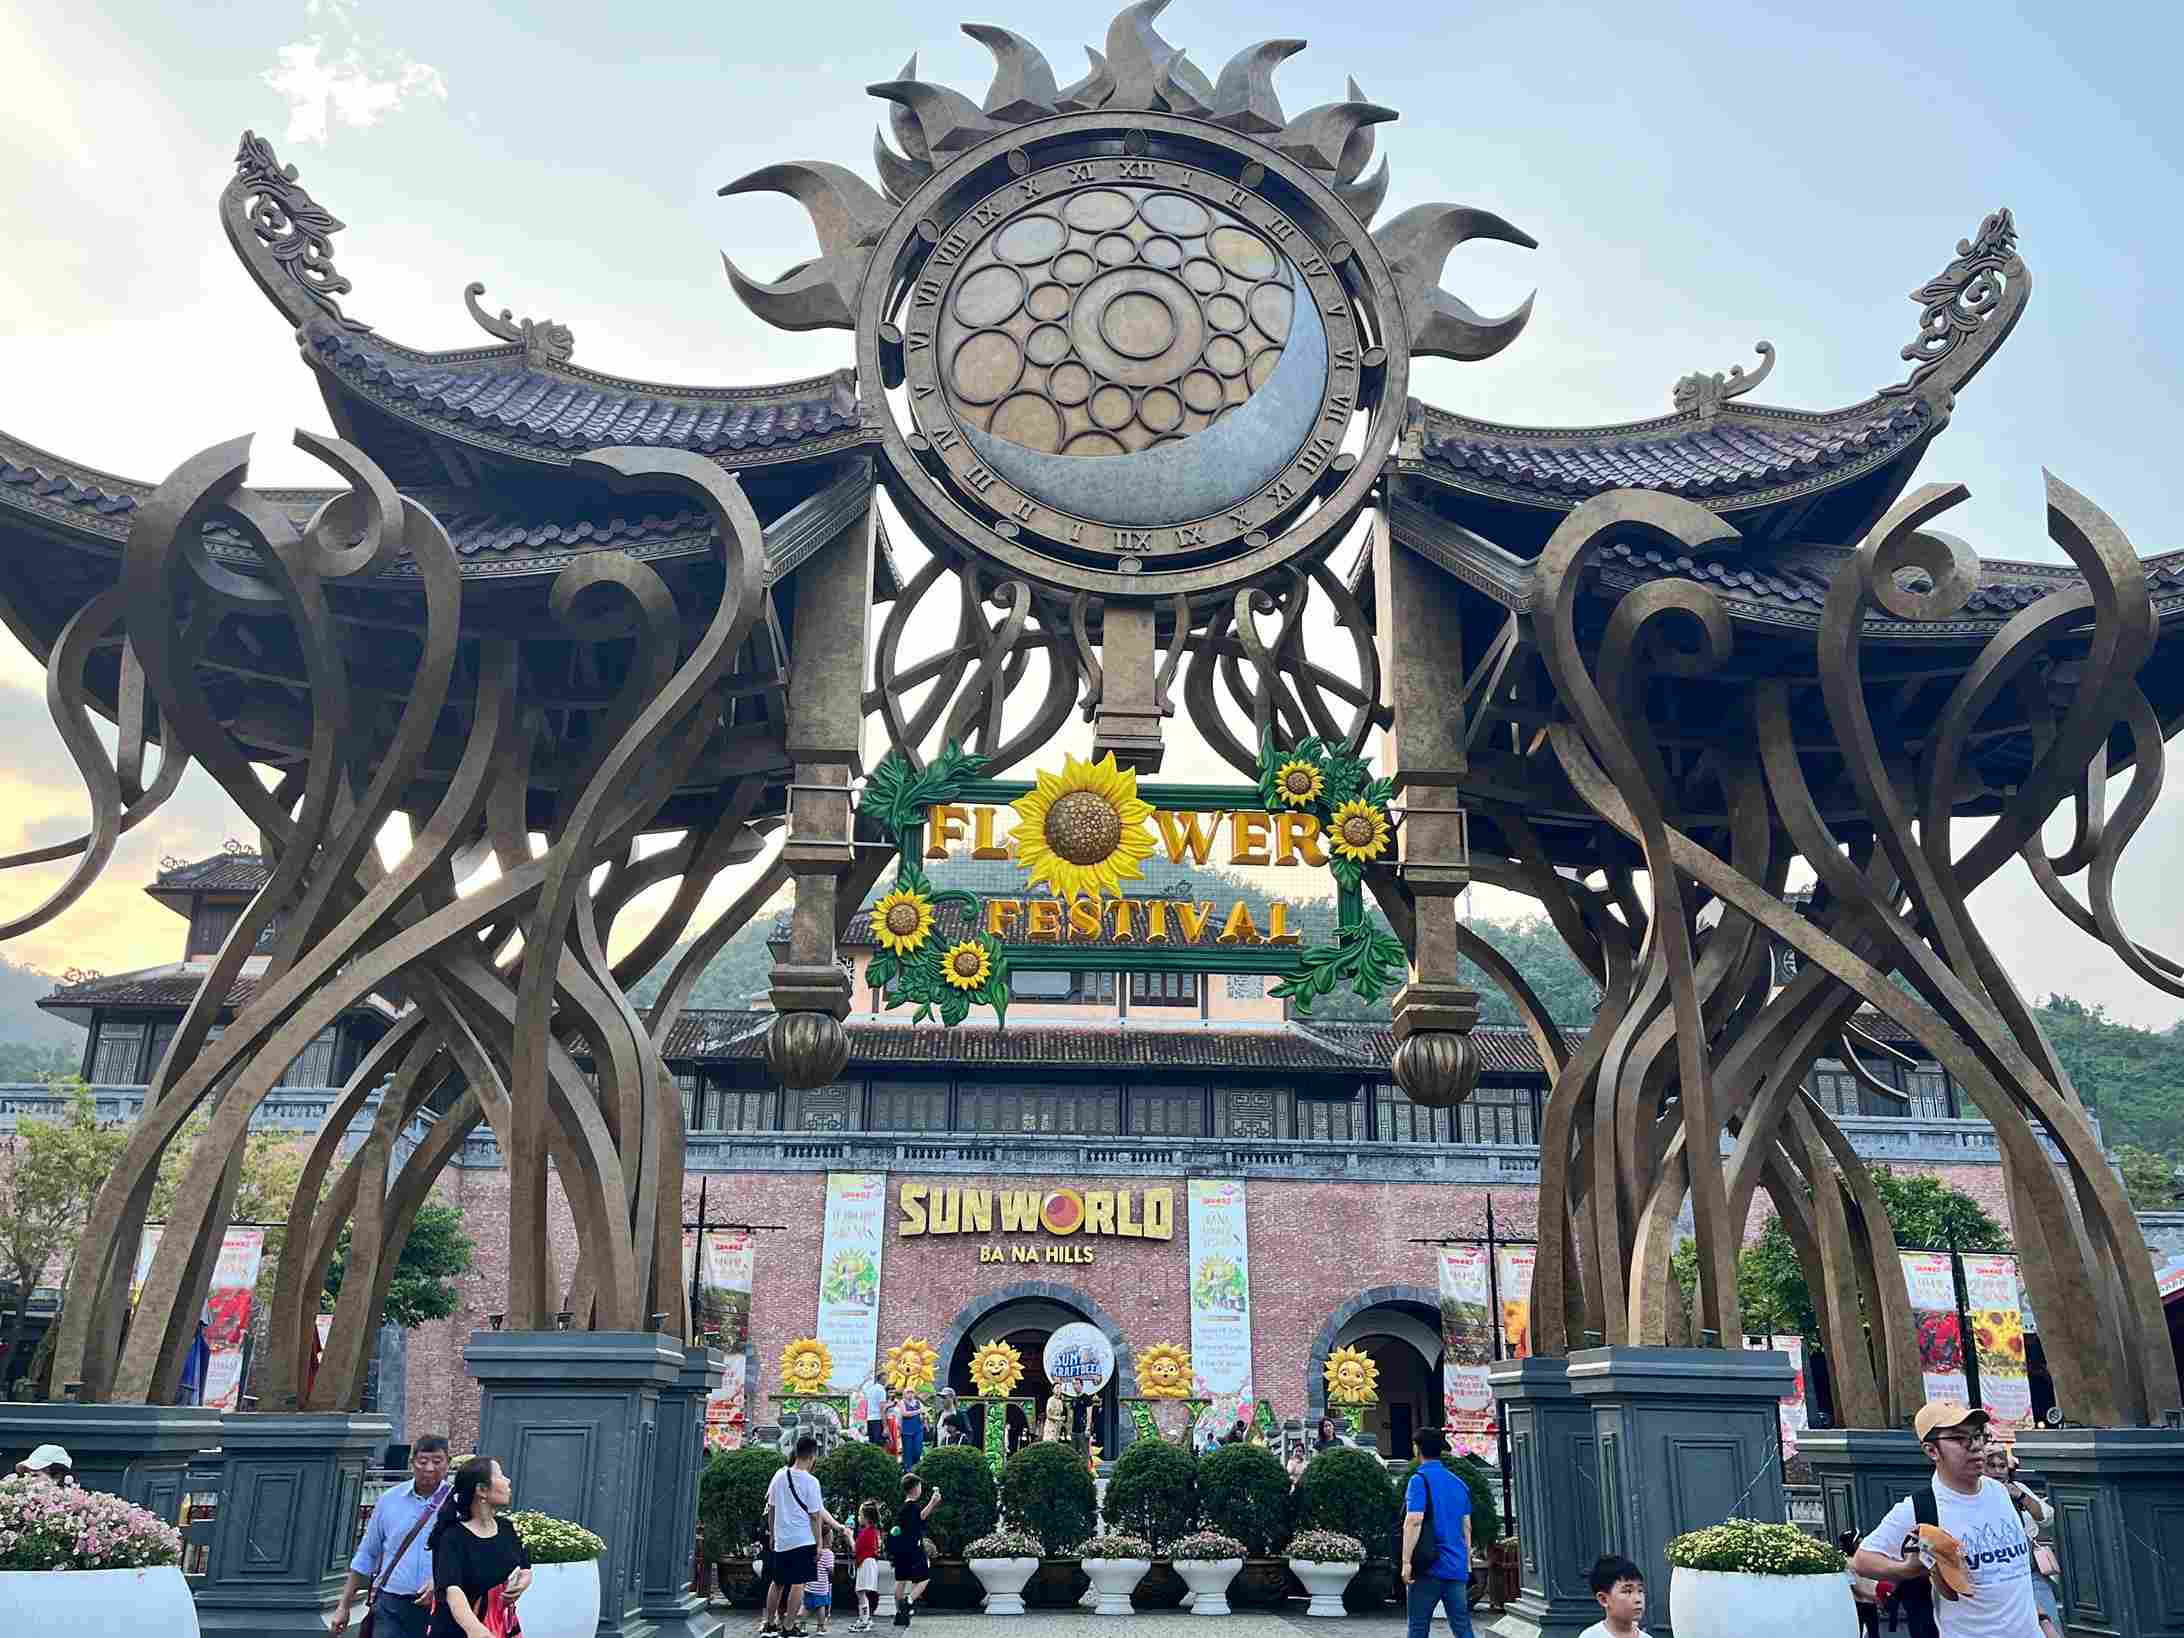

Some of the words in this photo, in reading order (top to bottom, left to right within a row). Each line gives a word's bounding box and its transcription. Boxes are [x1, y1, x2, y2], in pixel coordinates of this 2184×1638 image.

[985, 897, 1302, 946] FESTIVAL
[899, 1183, 993, 1236] SUN
[999, 1186, 1174, 1241] WORLD
[980, 1245, 1004, 1264] BA
[1011, 1246, 1039, 1265] NA
[1045, 1246, 1095, 1265] HILLS
